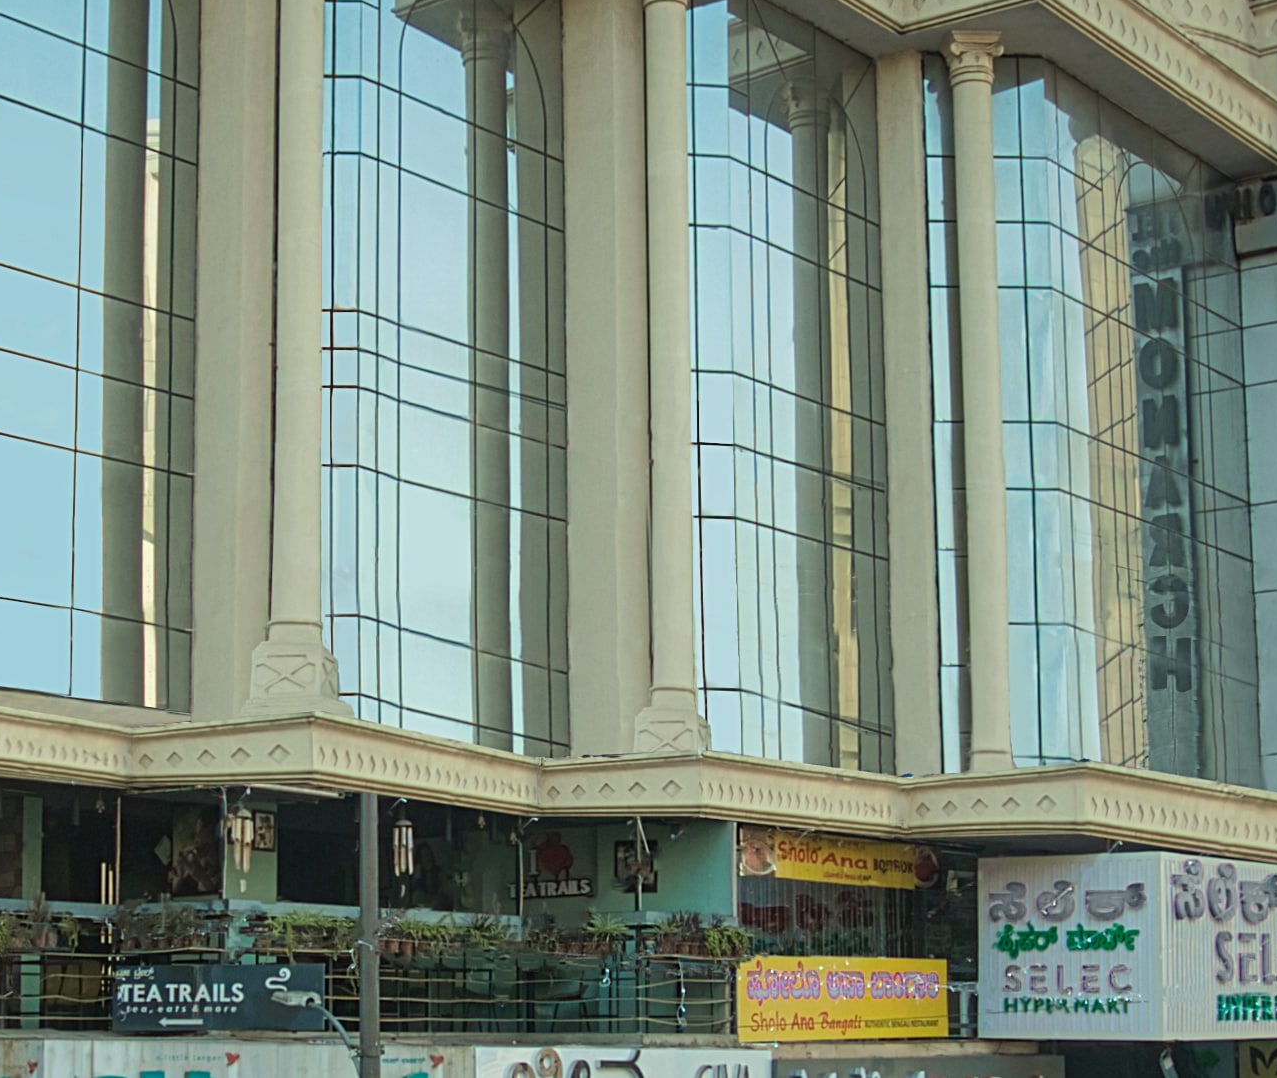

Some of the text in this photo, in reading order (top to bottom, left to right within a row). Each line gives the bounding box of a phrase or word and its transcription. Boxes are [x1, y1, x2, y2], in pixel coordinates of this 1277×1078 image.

[822, 852, 868, 870] Ana
[537, 879, 592, 897] TRAILS
[1002, 964, 1132, 994] SELEC
[121, 983, 244, 1003] TEA TRAILS
[157, 1005, 187, 1013] eats
[203, 1005, 237, 1013] more
[751, 1011, 786, 1033] Sholo
[791, 1012, 816, 1031] Ana
[819, 1011, 862, 1035] Bangali
